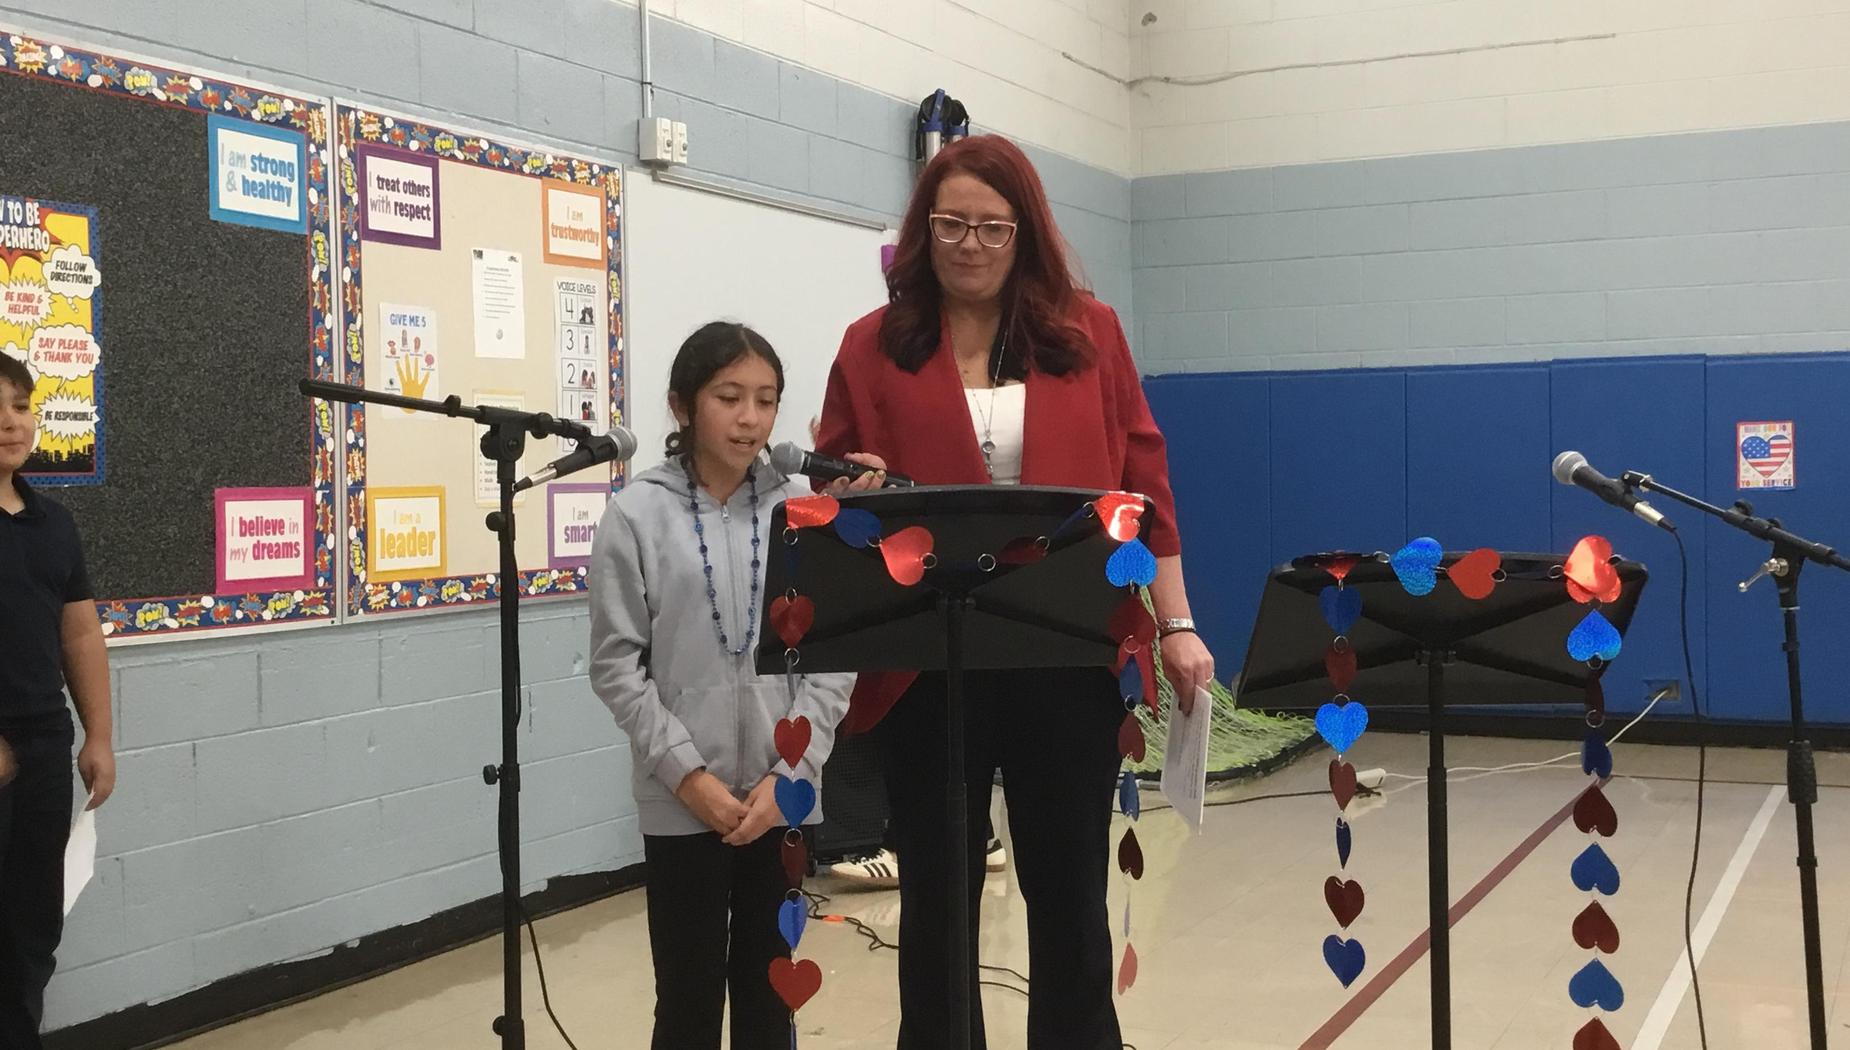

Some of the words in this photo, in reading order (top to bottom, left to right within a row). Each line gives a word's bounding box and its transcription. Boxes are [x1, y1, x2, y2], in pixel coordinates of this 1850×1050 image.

[228, 150, 247, 168] am
[250, 152, 295, 182] strong
[226, 170, 237, 192] &
[241, 174, 292, 207] healthy
[376, 174, 400, 193] treat
[402, 179, 430, 198] others
[7, 200, 23, 224] TO
[25, 201, 40, 226] BE
[369, 195, 391, 214] with
[394, 201, 431, 221] respect
[551, 223, 599, 246] trustworthy
[55, 260, 87, 272] FOLLOW
[50, 271, 93, 285] DIRECTIONS
[557, 281, 576, 292] VOICE
[577, 283, 597, 295] LEVELS
[5, 291, 14, 302] BE
[17, 292, 35, 304] KIND
[565, 297, 574, 319] 4
[8, 304, 40, 316] HELPFUL
[389, 313, 407, 327] GIVE
[409, 315, 420, 328] ME
[422, 316, 427, 328] 5
[38, 337, 55, 349] SAY
[57, 338, 88, 351] PLEASE
[566, 329, 574, 351] 3
[33, 351, 40, 362] &
[44, 351, 72, 363] THANK
[75, 352, 94, 364] YOU
[567, 363, 576, 385] 2
[45, 410, 53, 420] BE
[54, 411, 93, 422] RESPONSIBLE
[577, 510, 588, 520] am
[239, 516, 285, 537] believe
[289, 518, 299, 534] in
[564, 521, 597, 543] smart
[230, 547, 248, 563] my
[253, 540, 300, 560] dreams
[380, 526, 436, 559] leader
[271, 595, 290, 614] POW!
[139, 606, 163, 626] POW!
